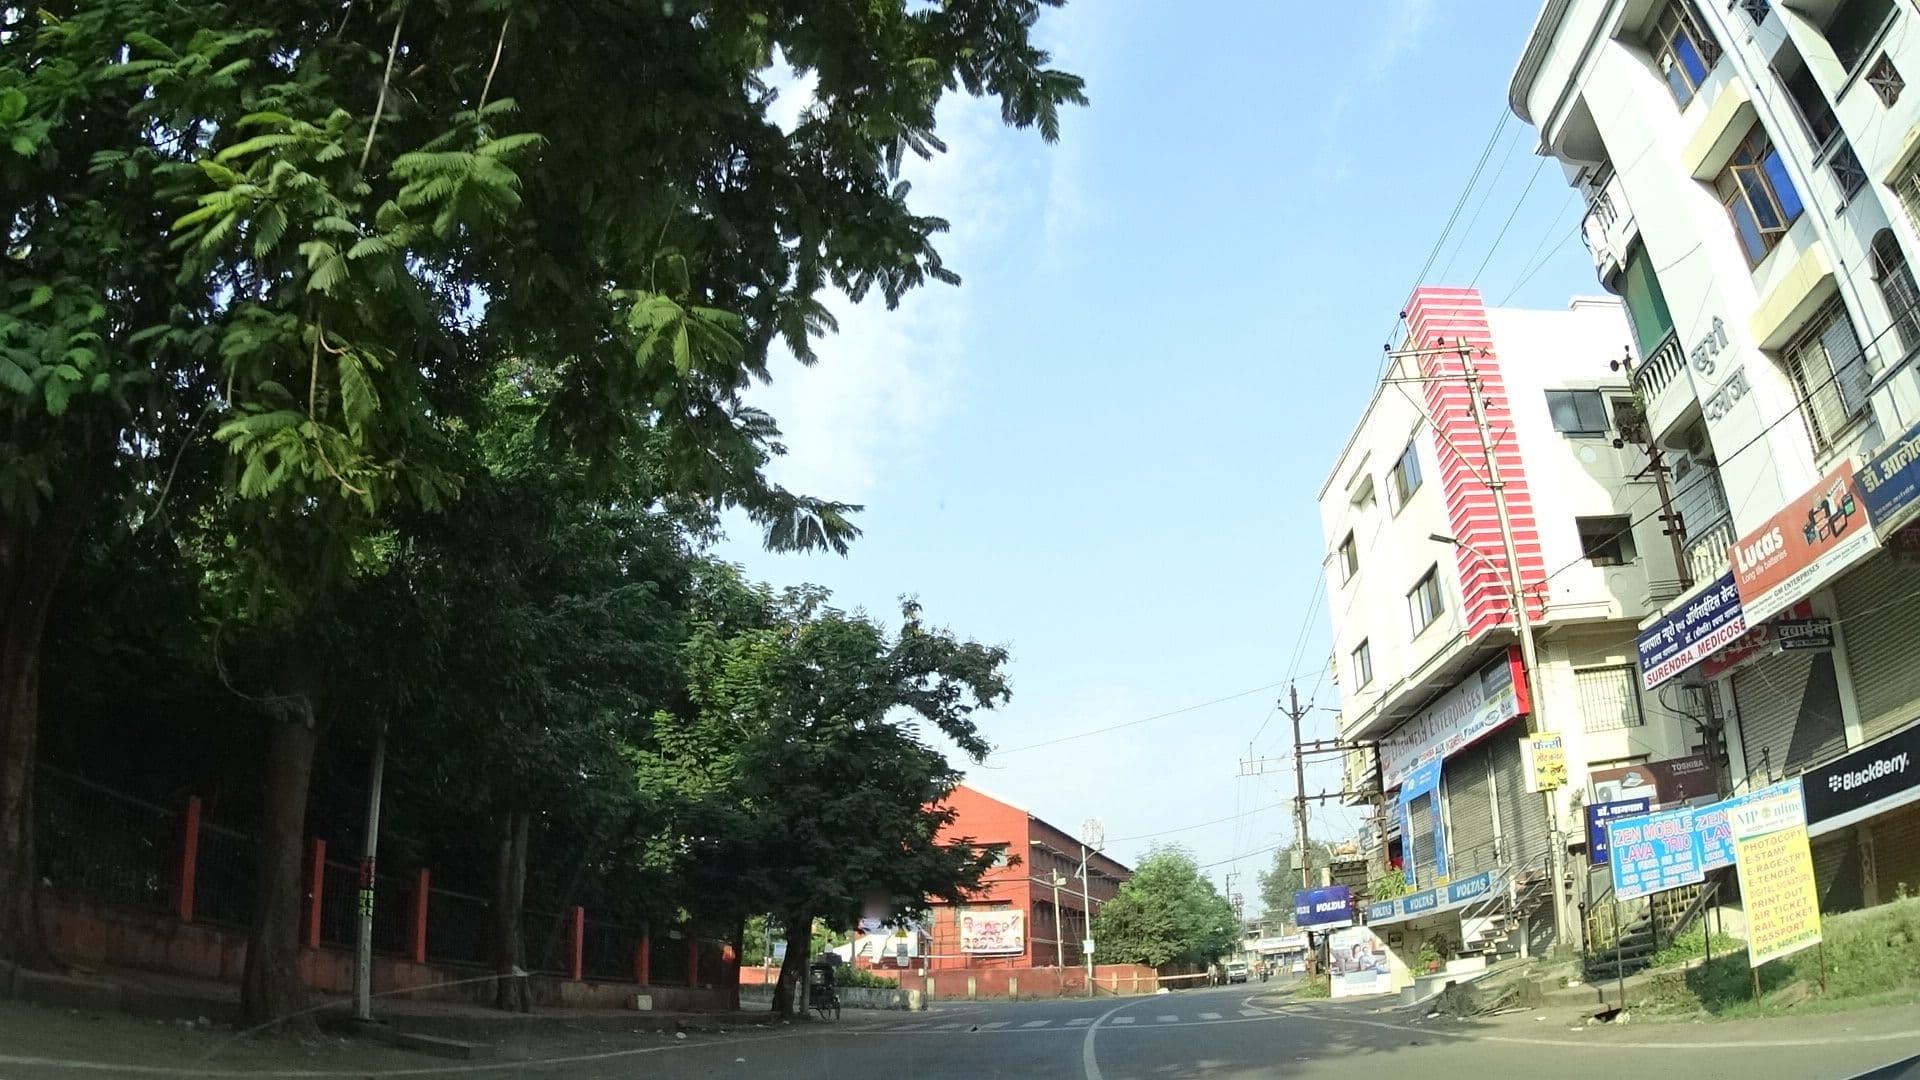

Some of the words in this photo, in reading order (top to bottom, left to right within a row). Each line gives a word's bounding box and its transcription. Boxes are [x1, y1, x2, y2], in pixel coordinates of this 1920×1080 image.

[1735, 526, 1784, 574] Lucas
[1742, 570, 1756, 585] Long
[1783, 564, 1820, 591] ENTERPRISES
[1647, 650, 1694, 686] SURENDRA
[1428, 688, 1482, 737] ENTERPRISES
[1671, 759, 1704, 771] TOSHIBA
[1843, 752, 1908, 791] BlackBerry
[1613, 826, 1640, 847] ZEN
[1643, 816, 1694, 840] MOBILE
[1695, 810, 1728, 831] ZEN
[1621, 842, 1655, 862] LAVA
[1662, 834, 1692, 854] TRIO
[1743, 830, 1803, 852] PHOTOCOPY
[1316, 900, 1346, 912] VOLTAS
[1371, 905, 1392, 918] VOLTAS
[1410, 894, 1435, 910] VOLTAS
[1456, 878, 1487, 898] VOLTAS
[1751, 895, 1780, 910] PRINT
[1784, 887, 1803, 900] OUT
[1754, 909, 1770, 921] AIR
[1774, 897, 1807, 915] TICKET
[1755, 919, 1777, 933] RAIL
[1780, 906, 1813, 925] TICKET
[1756, 921, 1805, 944] PASSPORT
